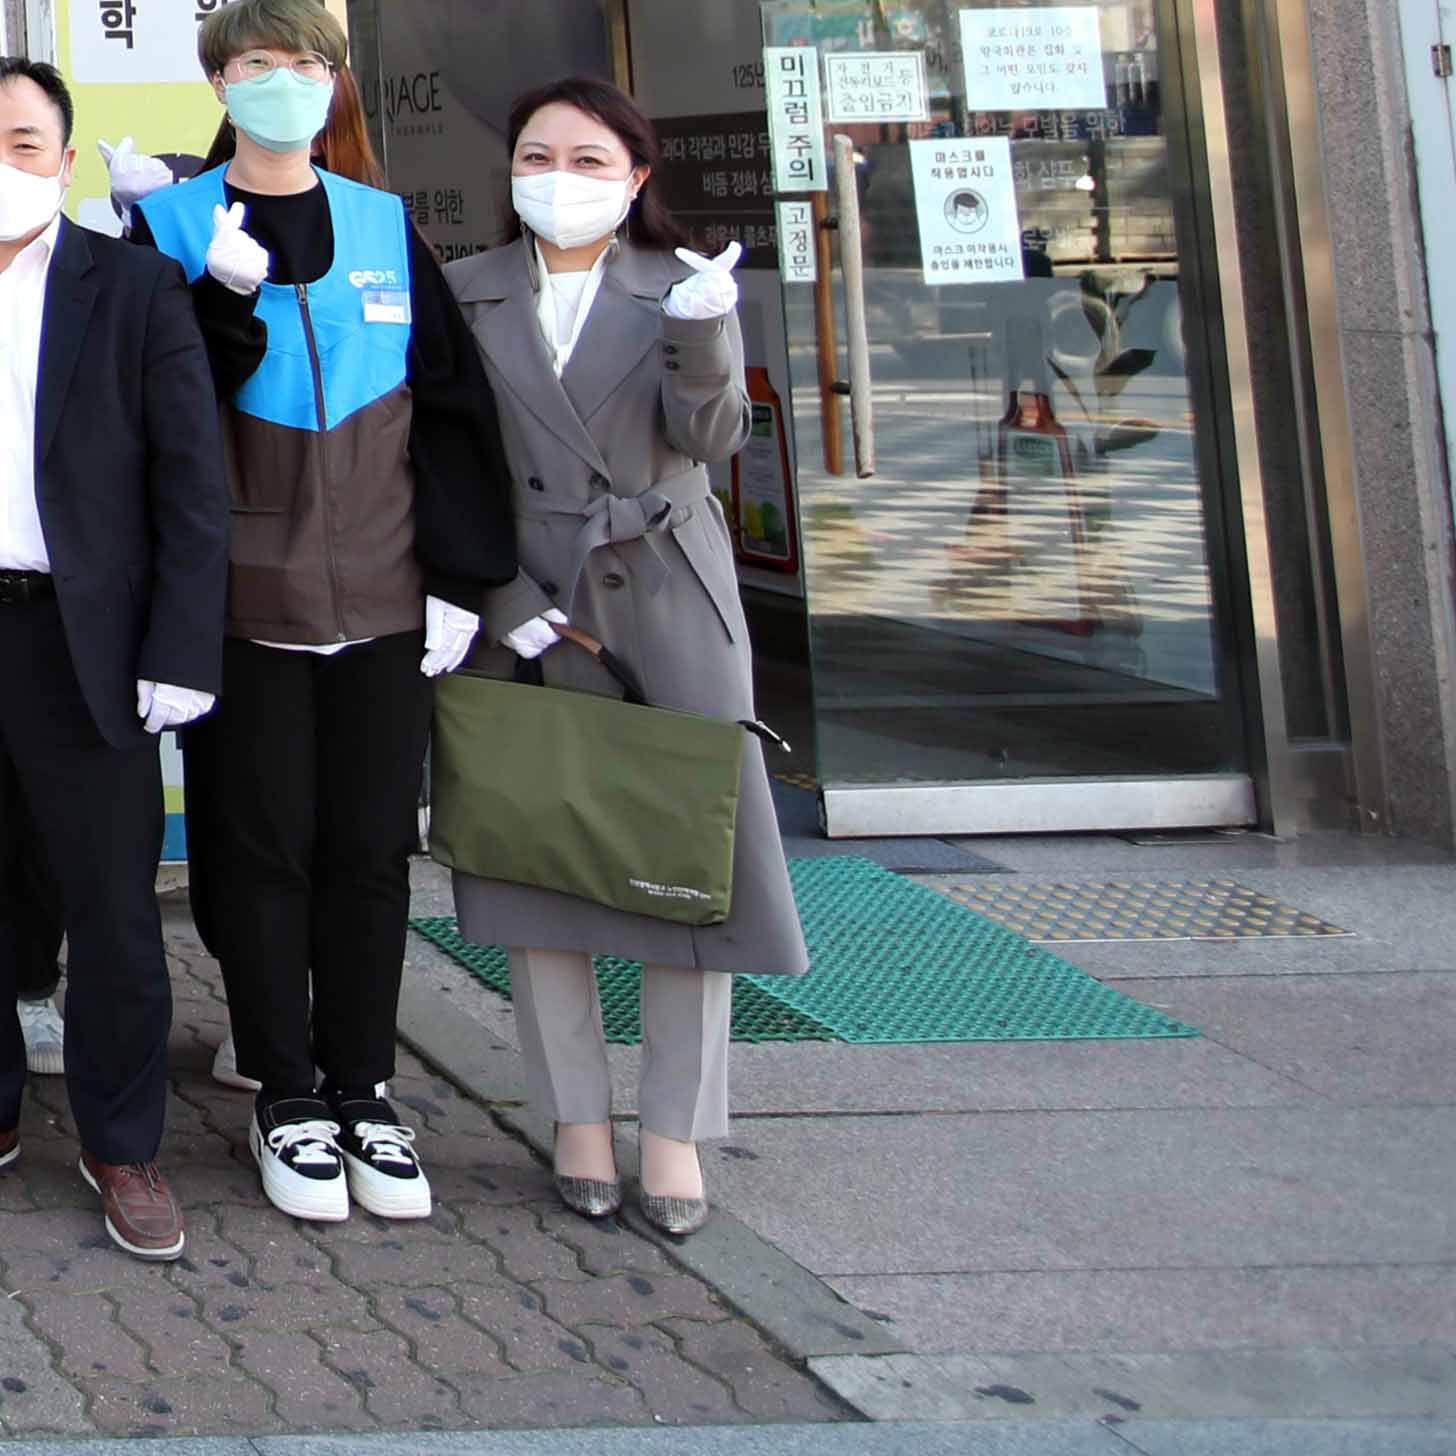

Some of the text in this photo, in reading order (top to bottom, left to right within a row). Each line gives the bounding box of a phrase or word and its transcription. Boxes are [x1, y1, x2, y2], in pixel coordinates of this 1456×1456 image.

[780, 55, 814, 181] 미끄럼 주의
[839, 94, 913, 113] 출입금지
[935, 149, 986, 163] 마스크를
[786, 206, 809, 278] 고정문
